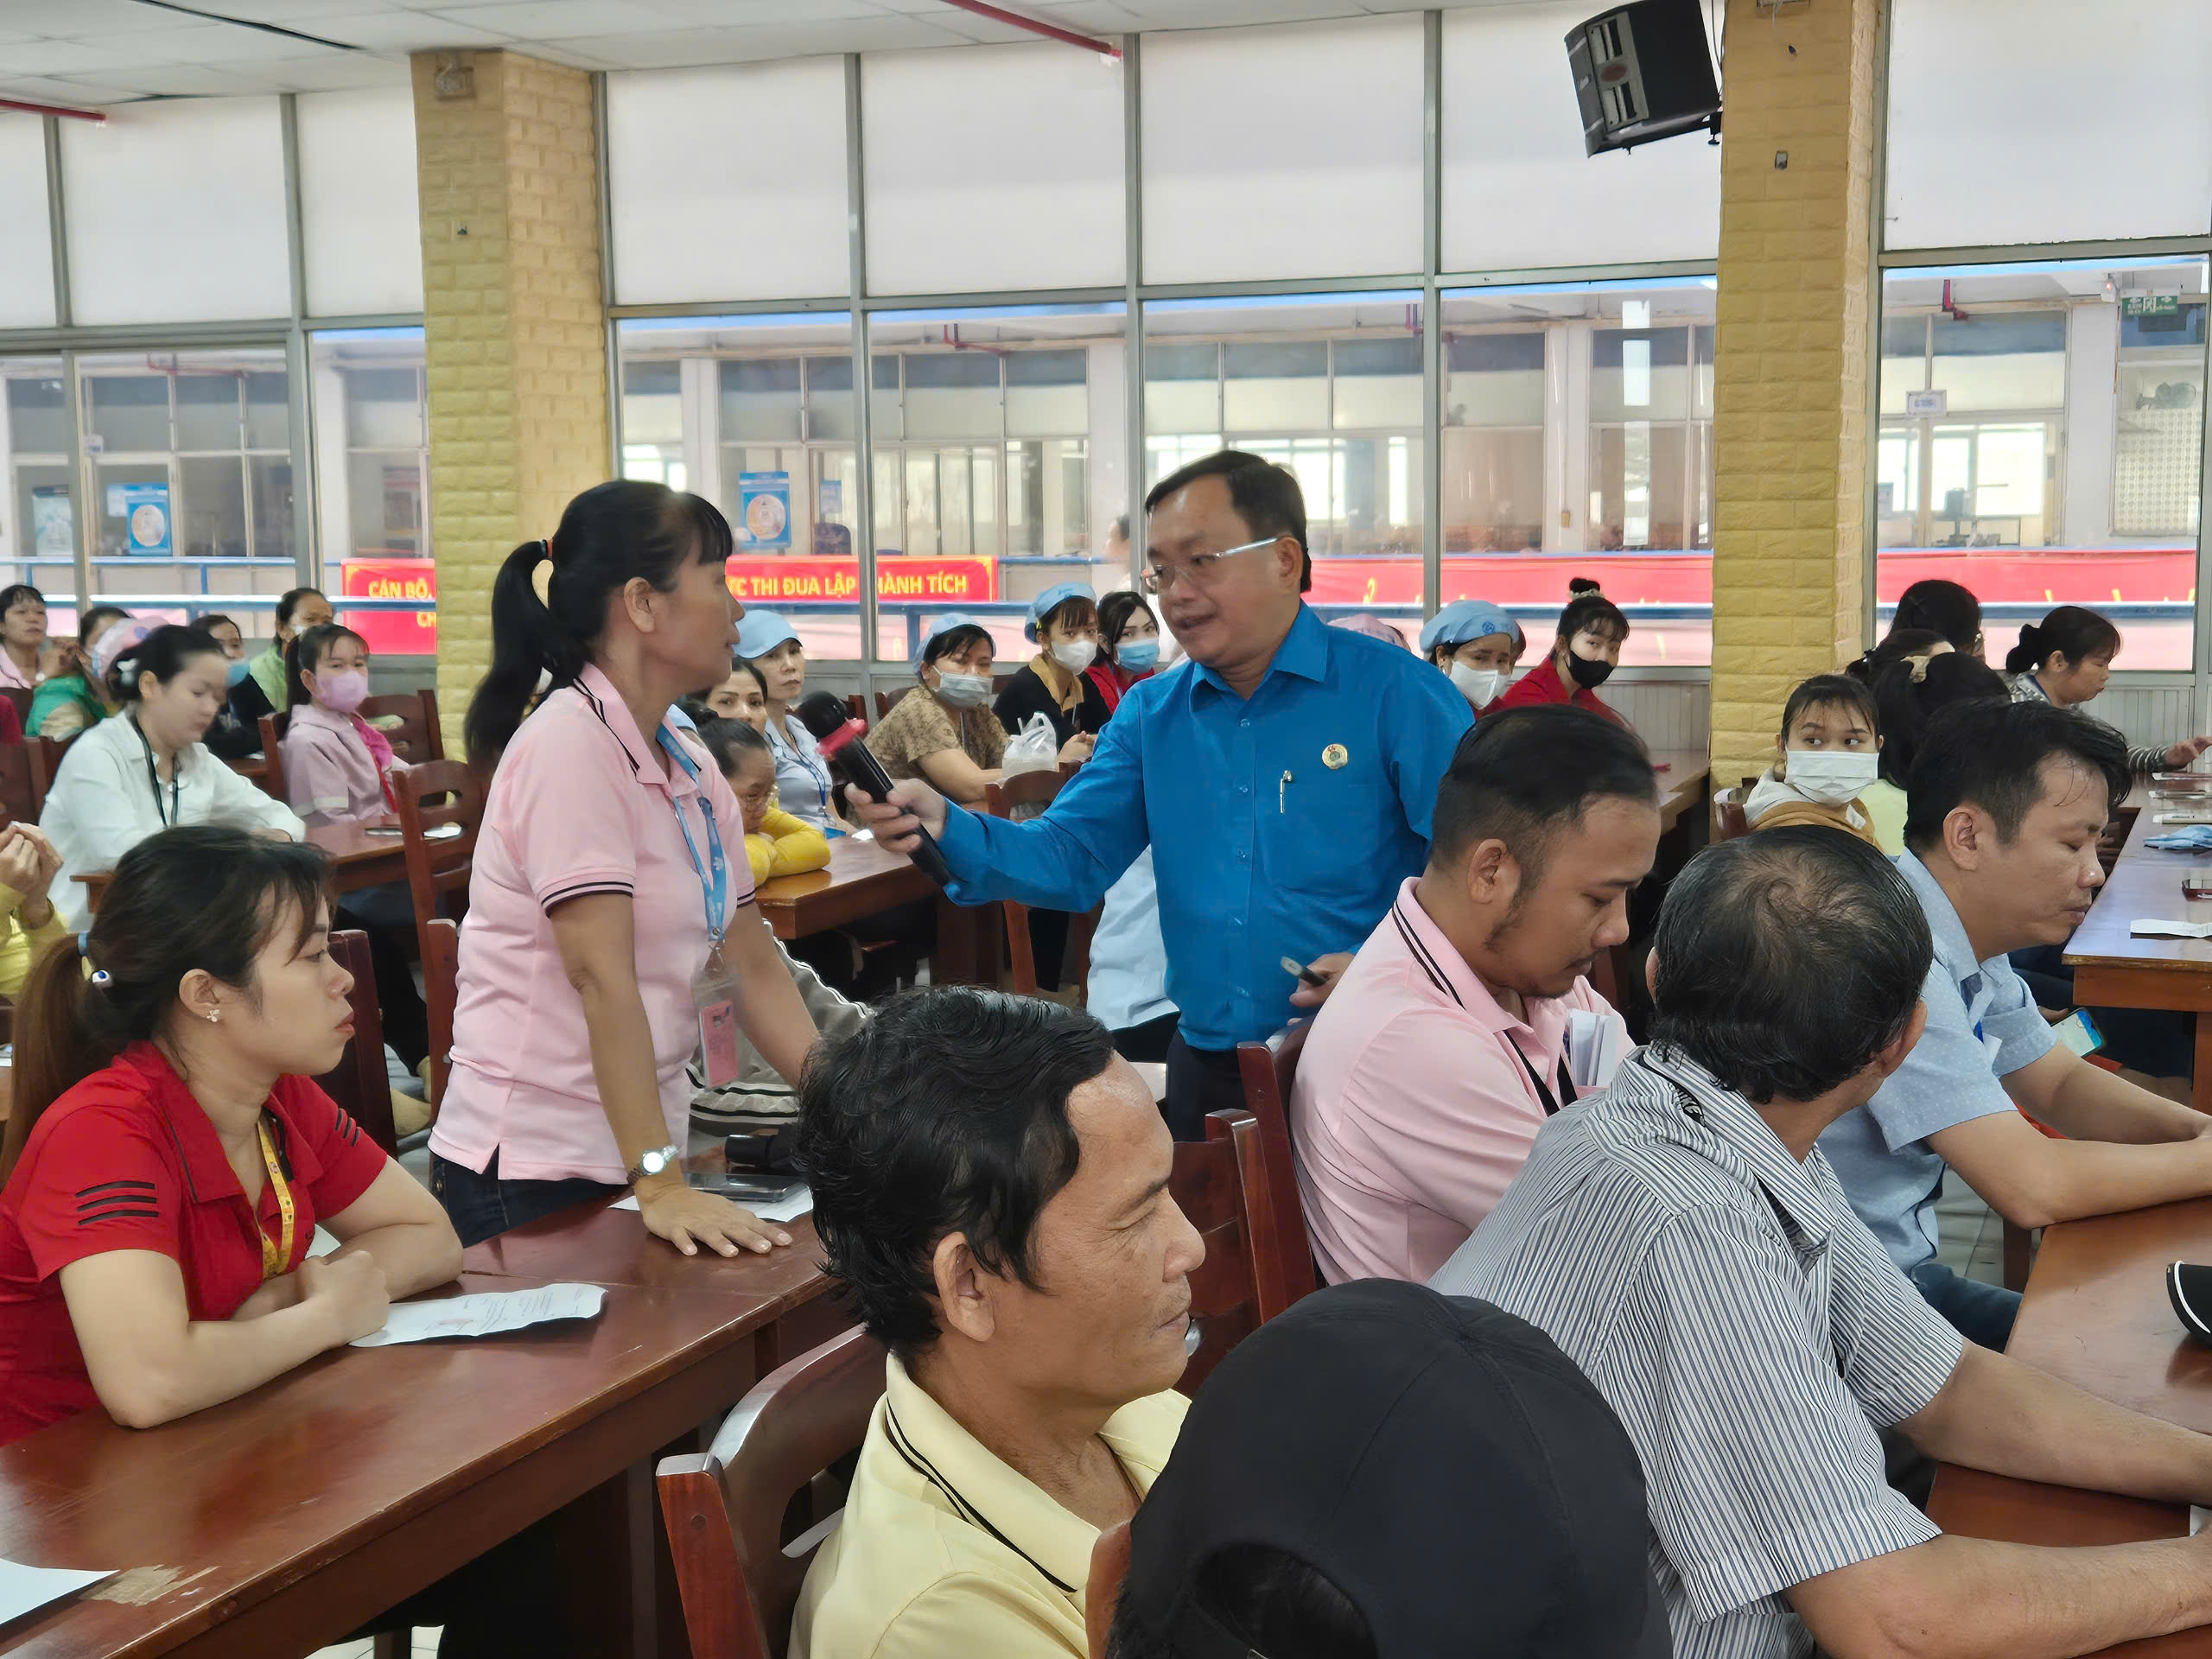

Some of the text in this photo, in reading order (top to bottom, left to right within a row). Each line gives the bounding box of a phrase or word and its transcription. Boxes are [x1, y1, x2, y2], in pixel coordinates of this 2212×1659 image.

[750, 576, 779, 596] THI
[782, 576, 820, 596] ĐUA
[824, 571, 856, 599] LẬP
[926, 571, 967, 594] TÍCH
